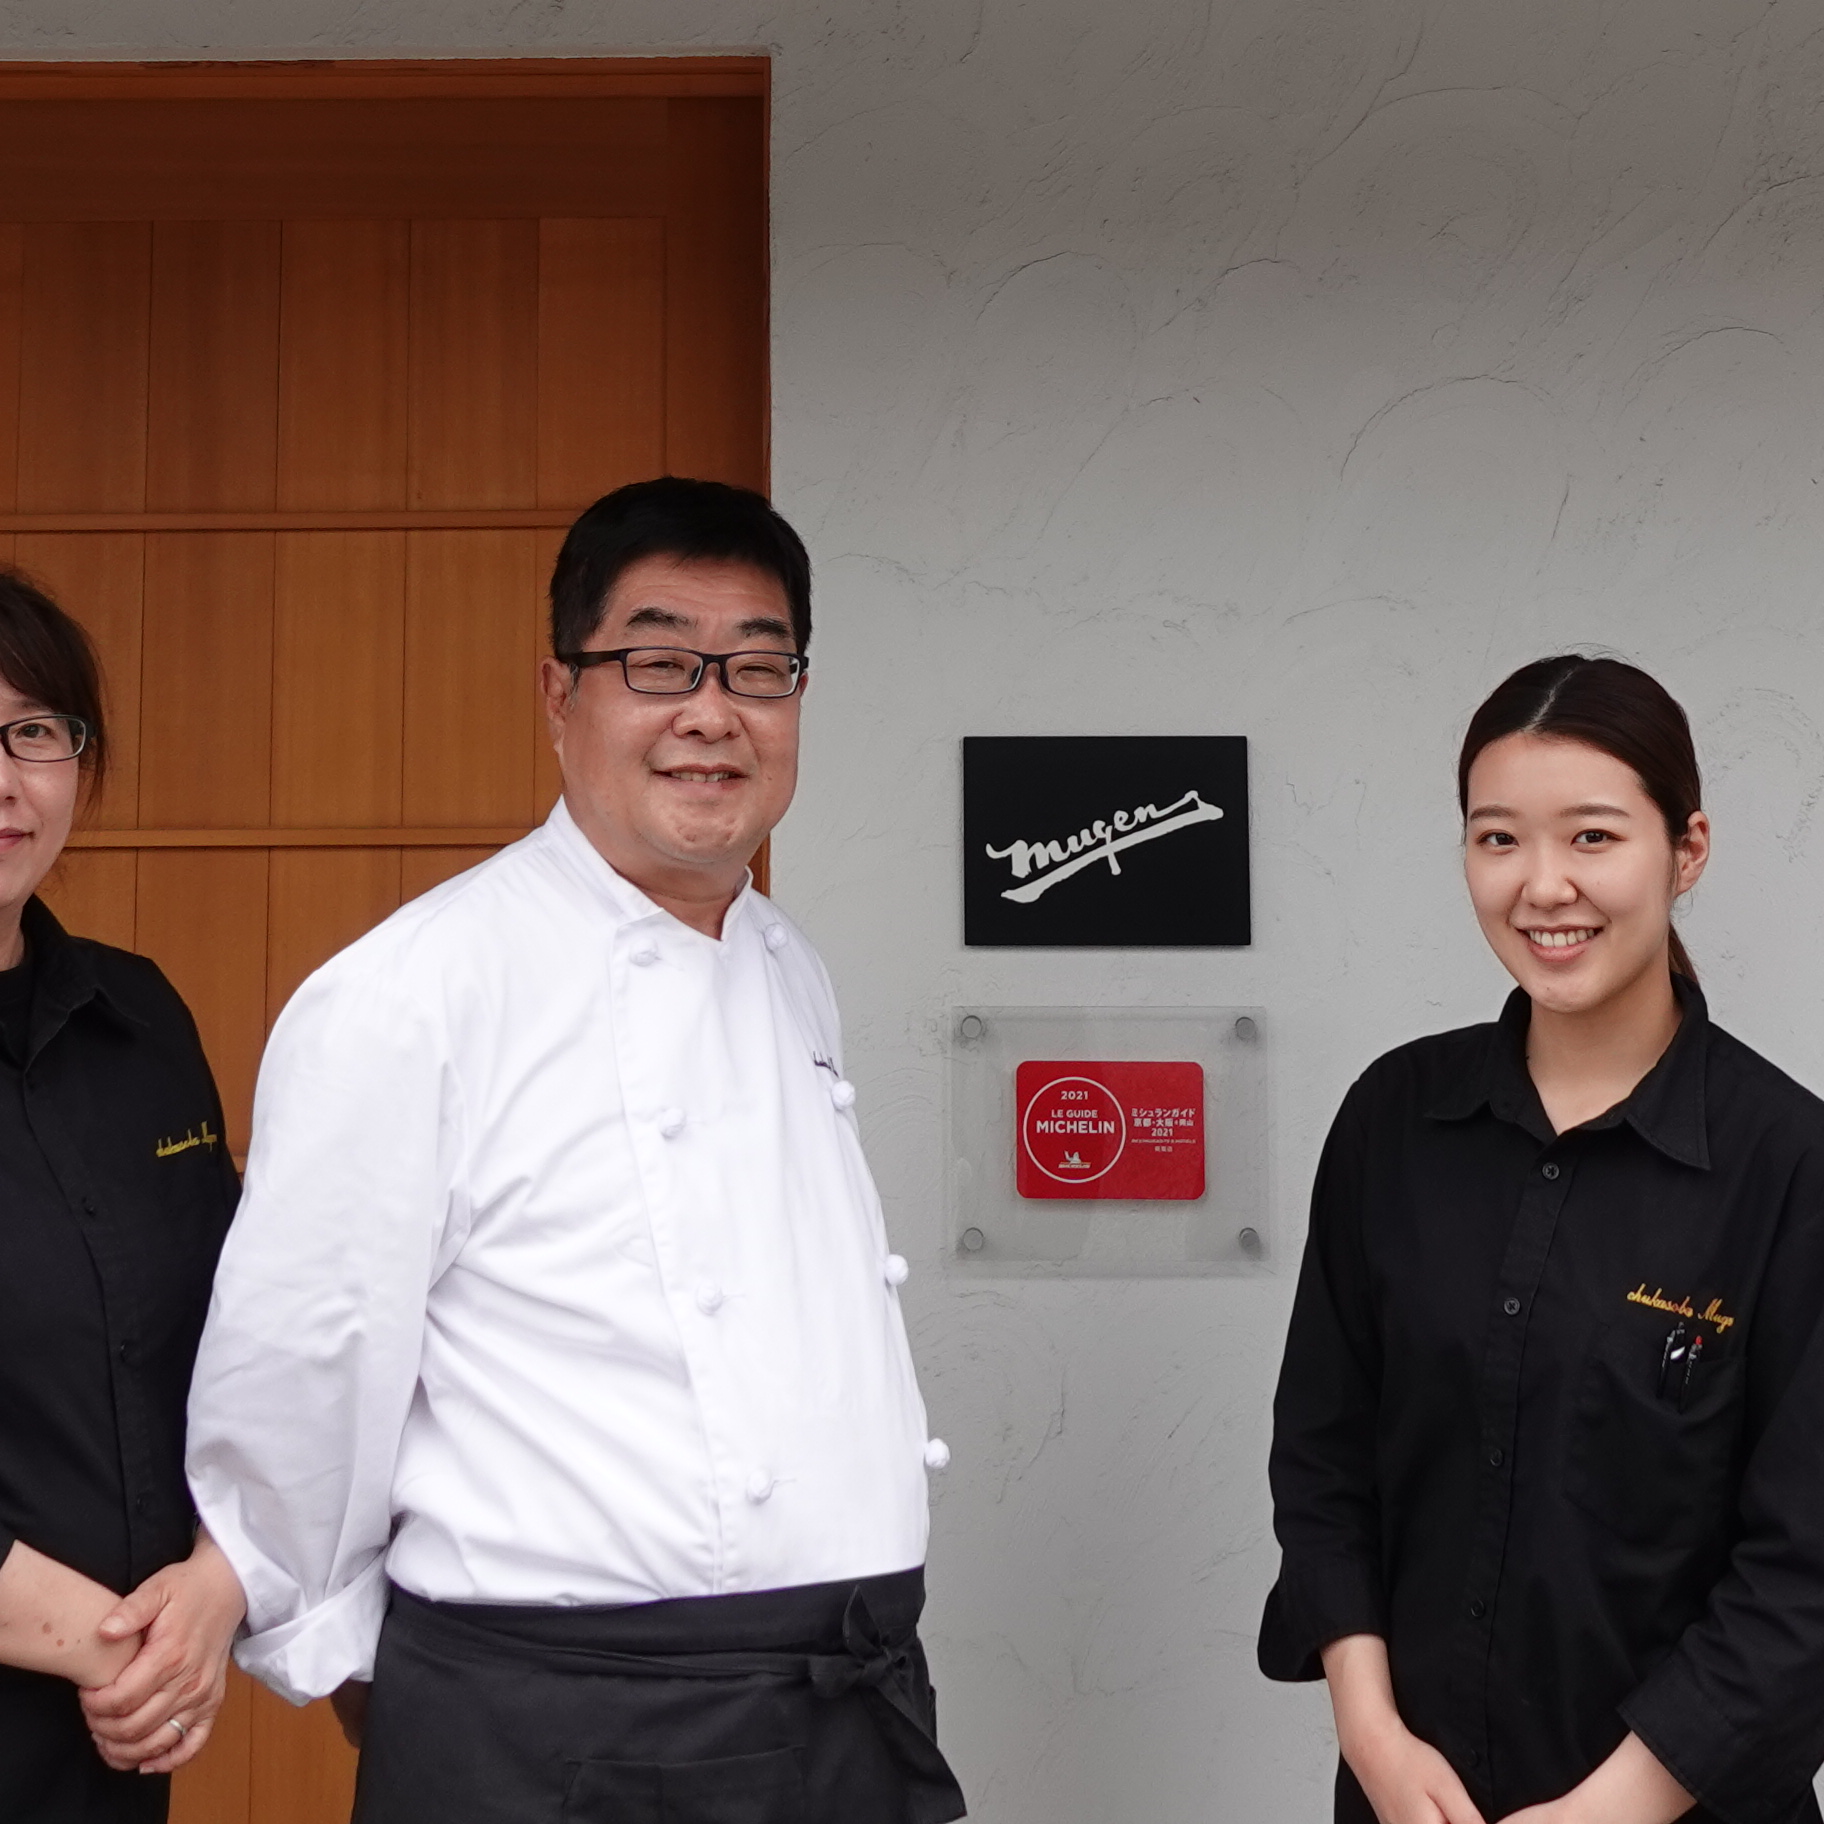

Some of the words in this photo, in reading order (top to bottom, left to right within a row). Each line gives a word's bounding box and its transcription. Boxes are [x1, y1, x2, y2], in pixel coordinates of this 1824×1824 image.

[985, 790, 1225, 903] mugen
[1060, 1090, 1089, 1100] 2021
[1051, 1109, 1064, 1118] LE
[1066, 1109, 1098, 1118] GUIDE
[1036, 1120, 1115, 1134] MICHELIN
[1151, 1128, 1174, 1137] 2021
